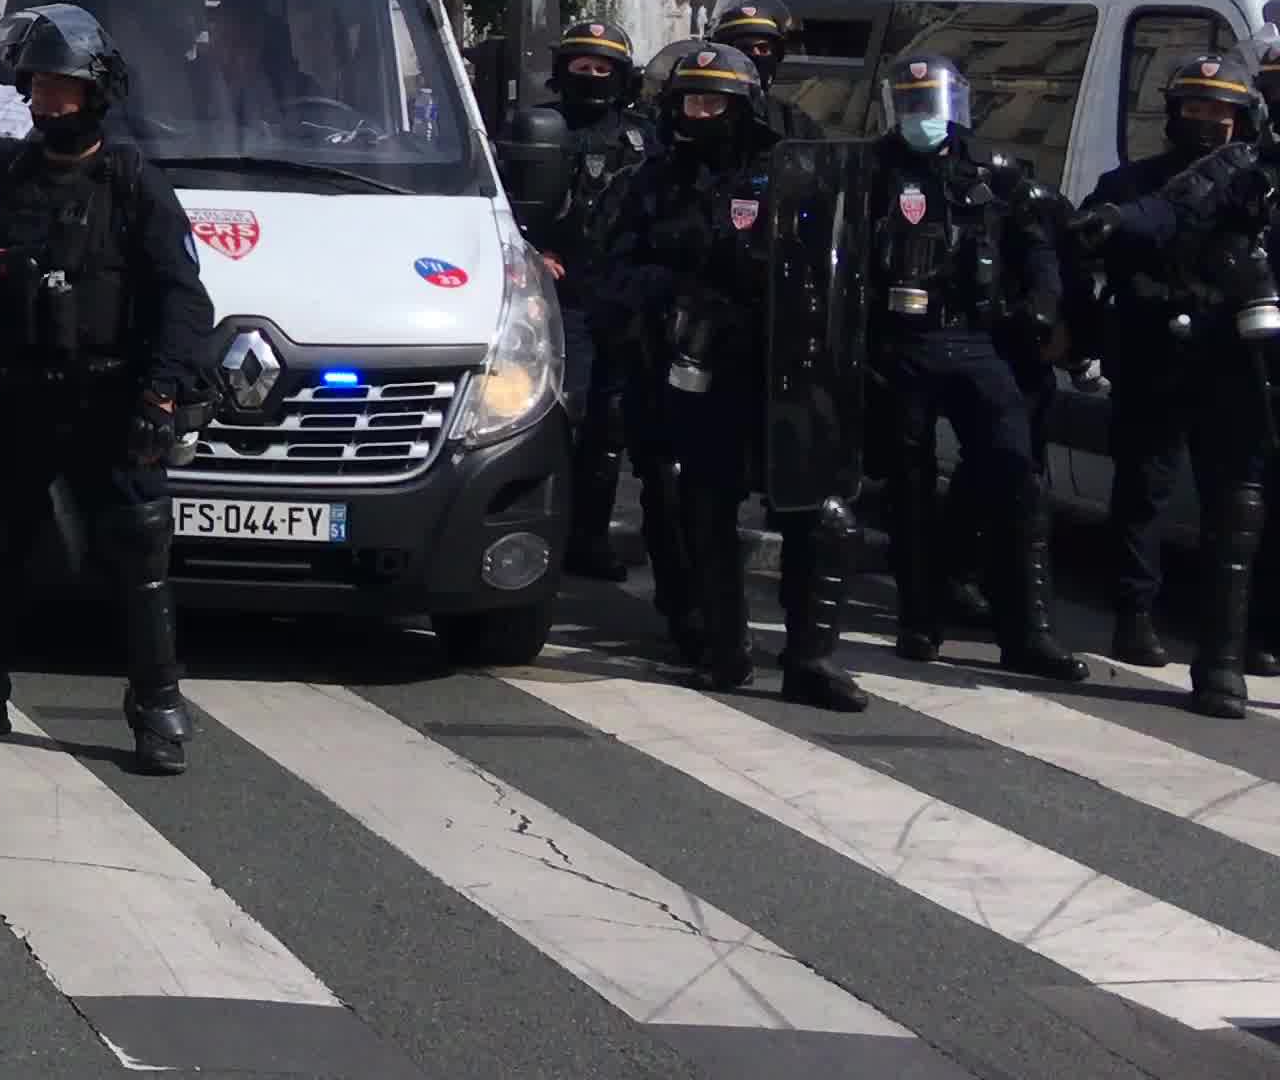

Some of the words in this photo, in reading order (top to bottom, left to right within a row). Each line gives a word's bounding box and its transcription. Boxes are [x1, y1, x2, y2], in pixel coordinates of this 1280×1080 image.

[193, 223, 257, 238] CRS
[178, 503, 323, 537] FS-044-FY
[330, 522, 346, 539] 51
